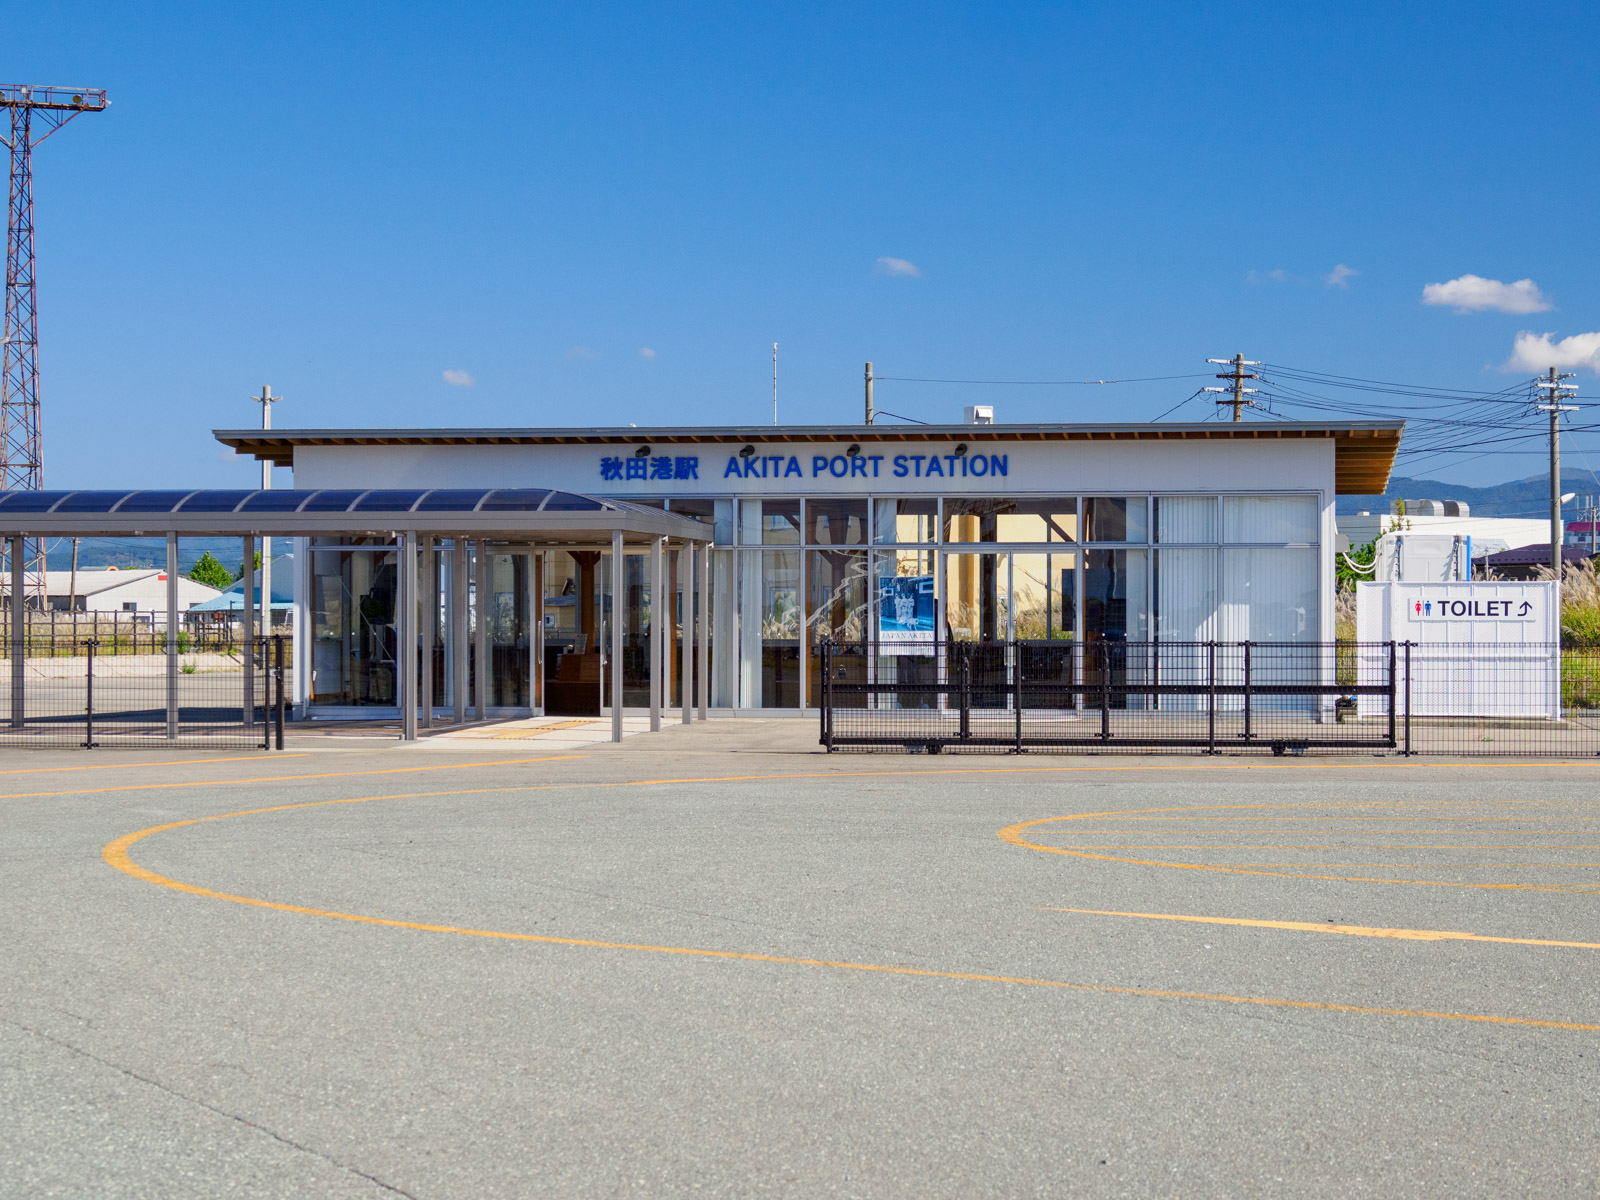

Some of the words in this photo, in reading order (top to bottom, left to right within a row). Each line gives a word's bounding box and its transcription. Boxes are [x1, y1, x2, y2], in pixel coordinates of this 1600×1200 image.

[600, 457, 699, 480] 秋田港駅
[724, 457, 803, 478] AKITA
[813, 456, 884, 478] PORT
[893, 454, 1008, 477] STATION
[1438, 601, 1513, 616] TOILET
